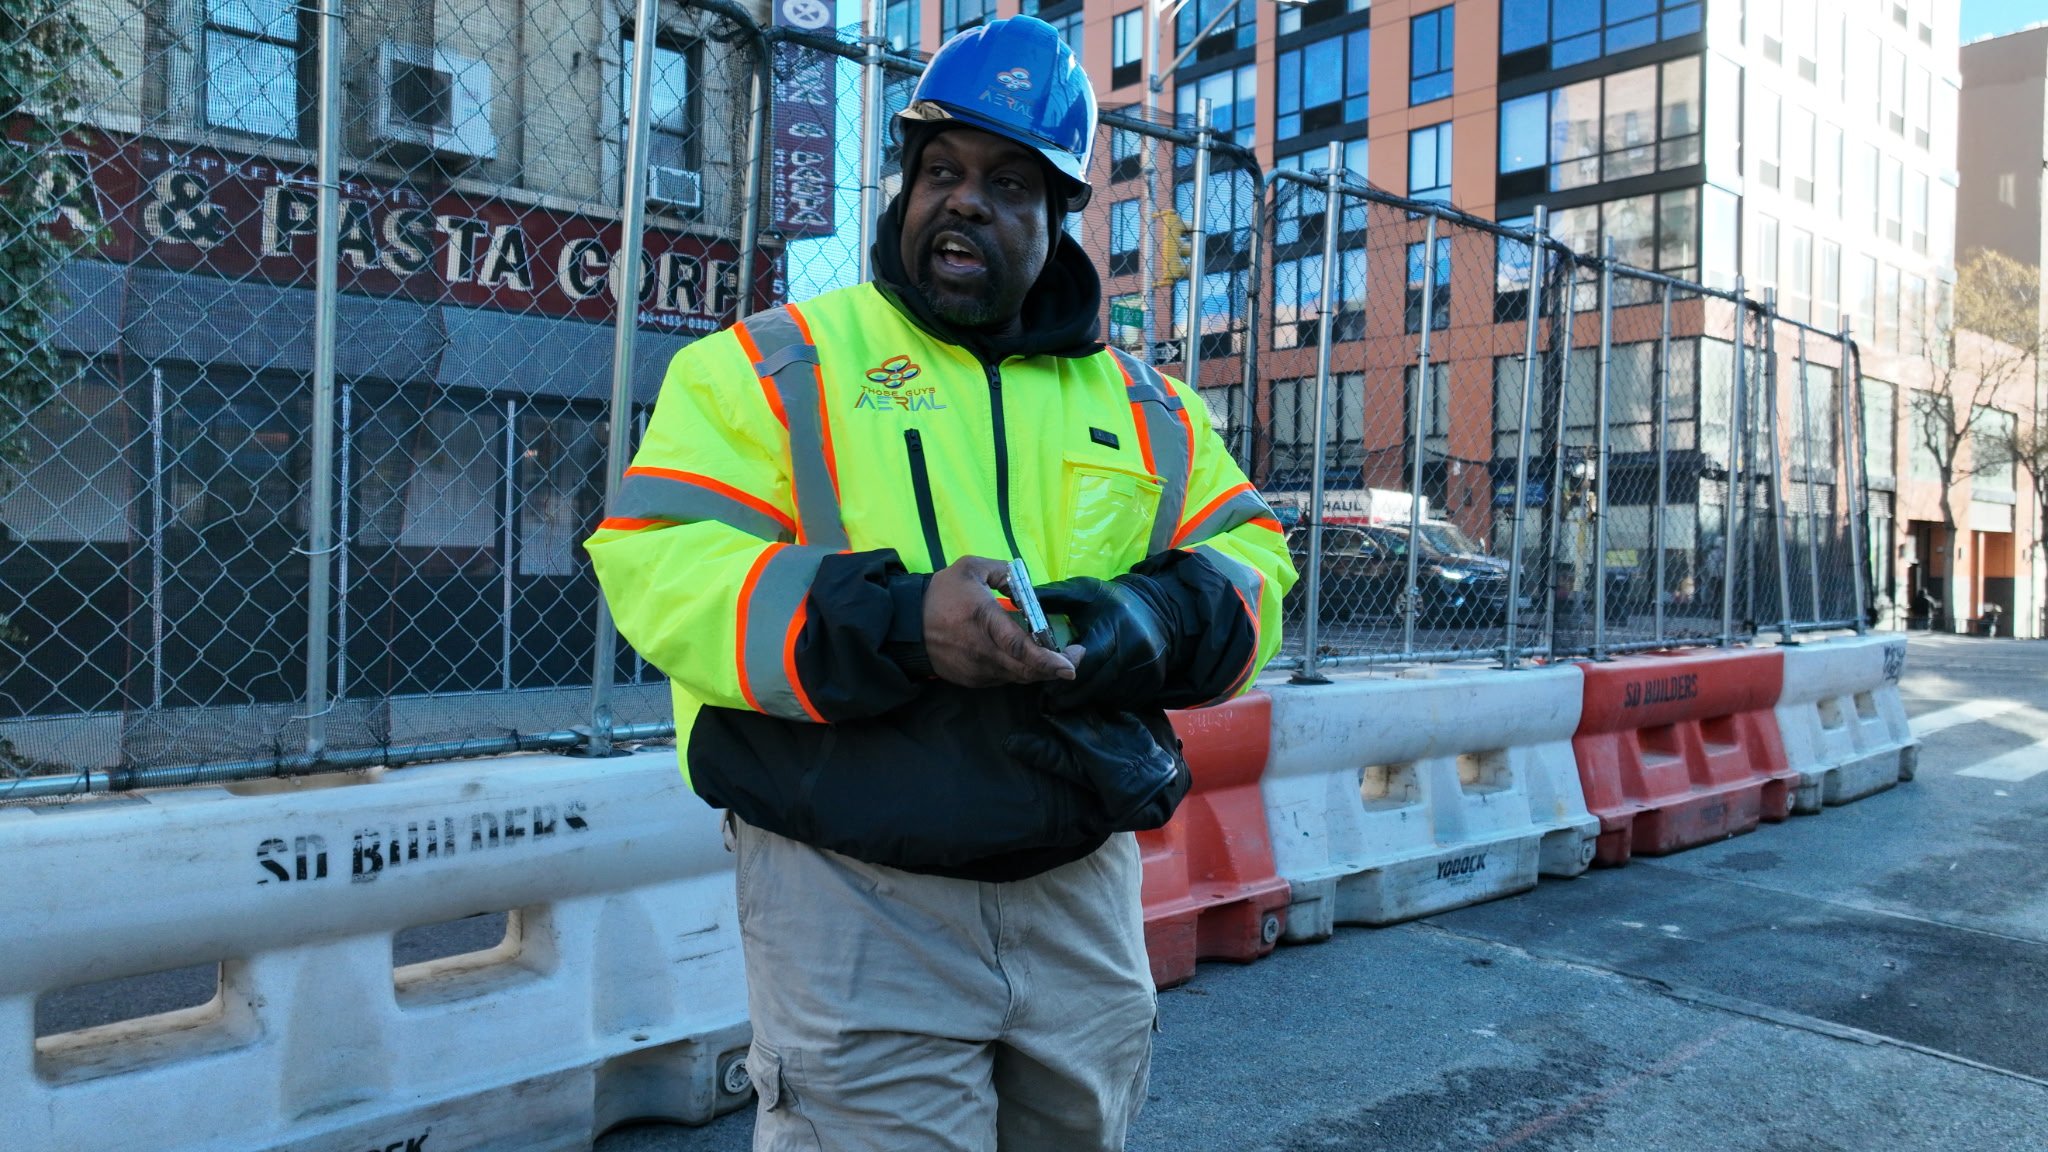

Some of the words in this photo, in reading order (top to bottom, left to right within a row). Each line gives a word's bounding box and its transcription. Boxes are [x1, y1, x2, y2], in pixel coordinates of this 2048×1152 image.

[978, 89, 1035, 119] AERIAL
[787, 150, 828, 226] PASTA
[143, 168, 226, 249] &
[260, 183, 534, 292] PASTA
[557, 237, 746, 316] CORP
[853, 391, 947, 411] AERIAL
[861, 384, 899, 397] THOSE
[905, 386, 936, 397] GUYS
[1623, 682, 1641, 708] SD
[1643, 673, 1698, 705] BUILDERS
[256, 834, 328, 885] SD
[1437, 852, 1487, 880] YODOCK
